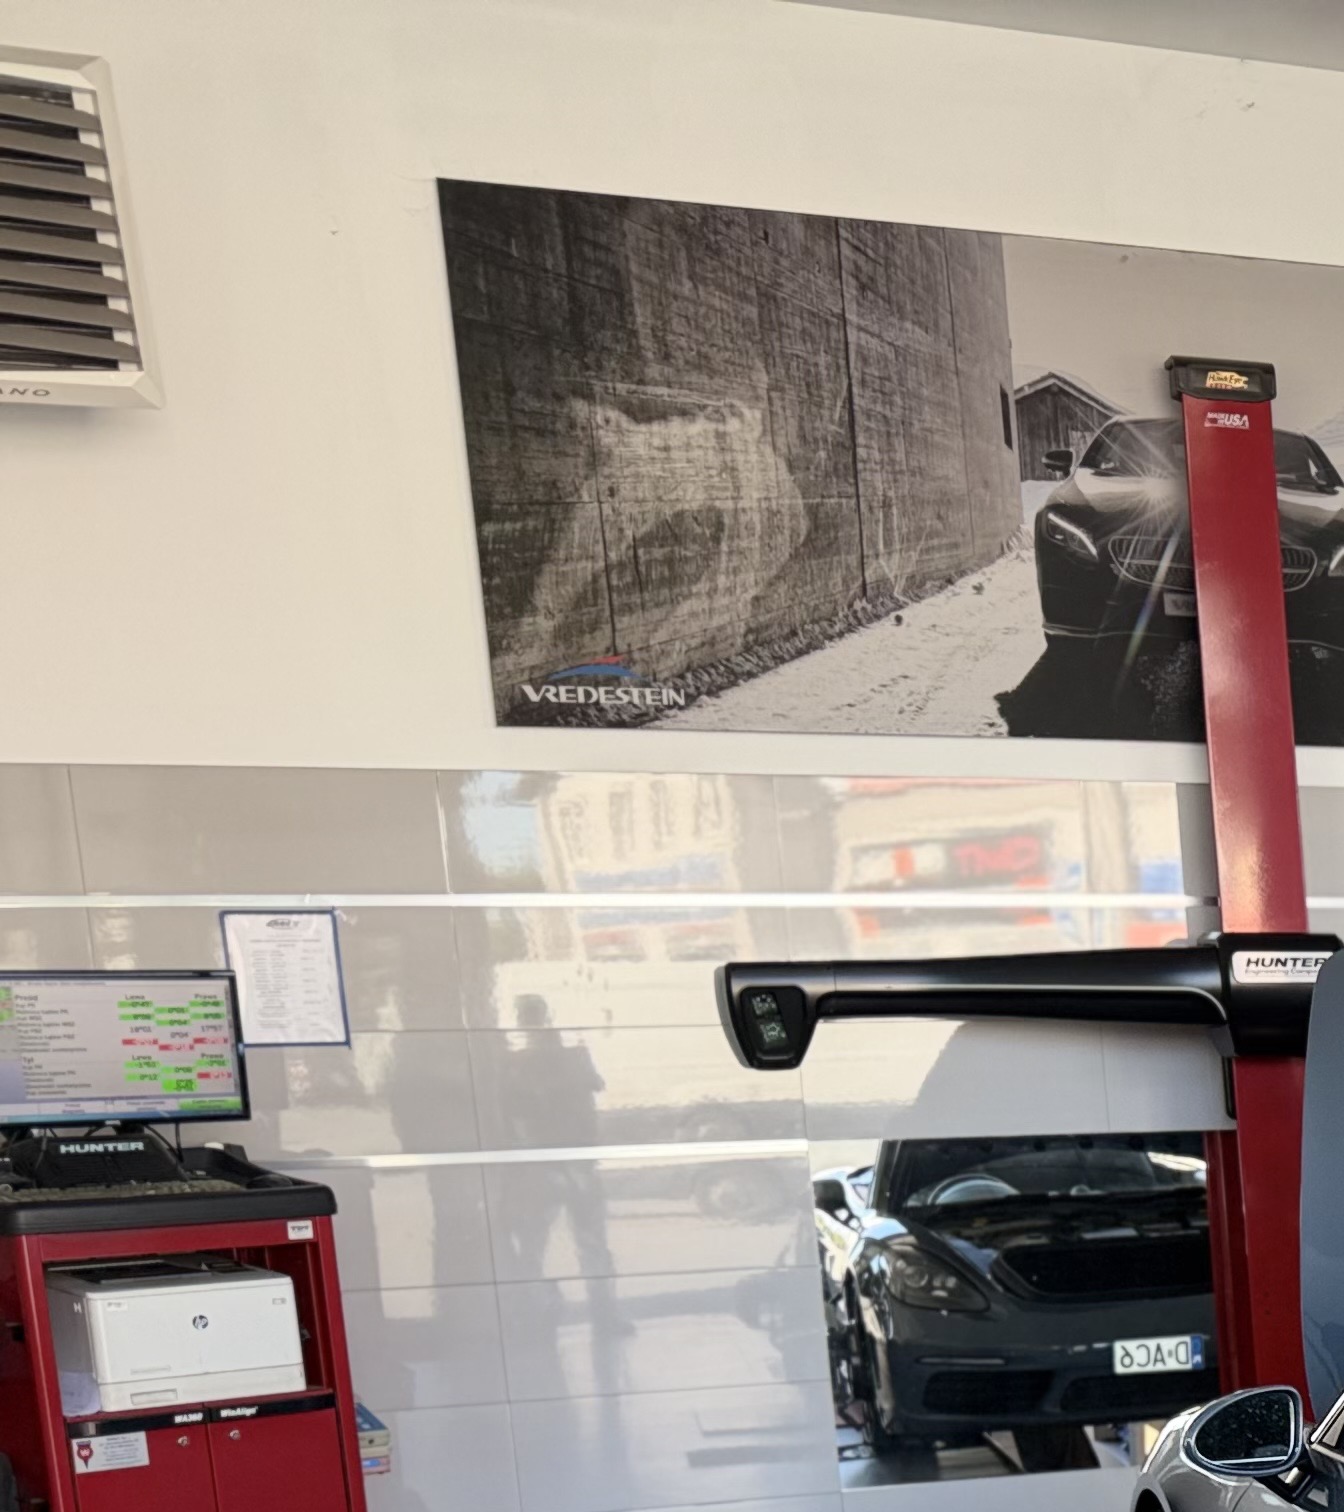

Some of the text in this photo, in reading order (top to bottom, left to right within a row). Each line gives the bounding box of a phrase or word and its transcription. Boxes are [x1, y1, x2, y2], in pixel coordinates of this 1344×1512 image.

[0, 388, 51, 396] NO
[1225, 413, 1249, 427] USA
[520, 684, 686, 706] VREDESTEIN
[60, 1141, 145, 1154] HUNTER
